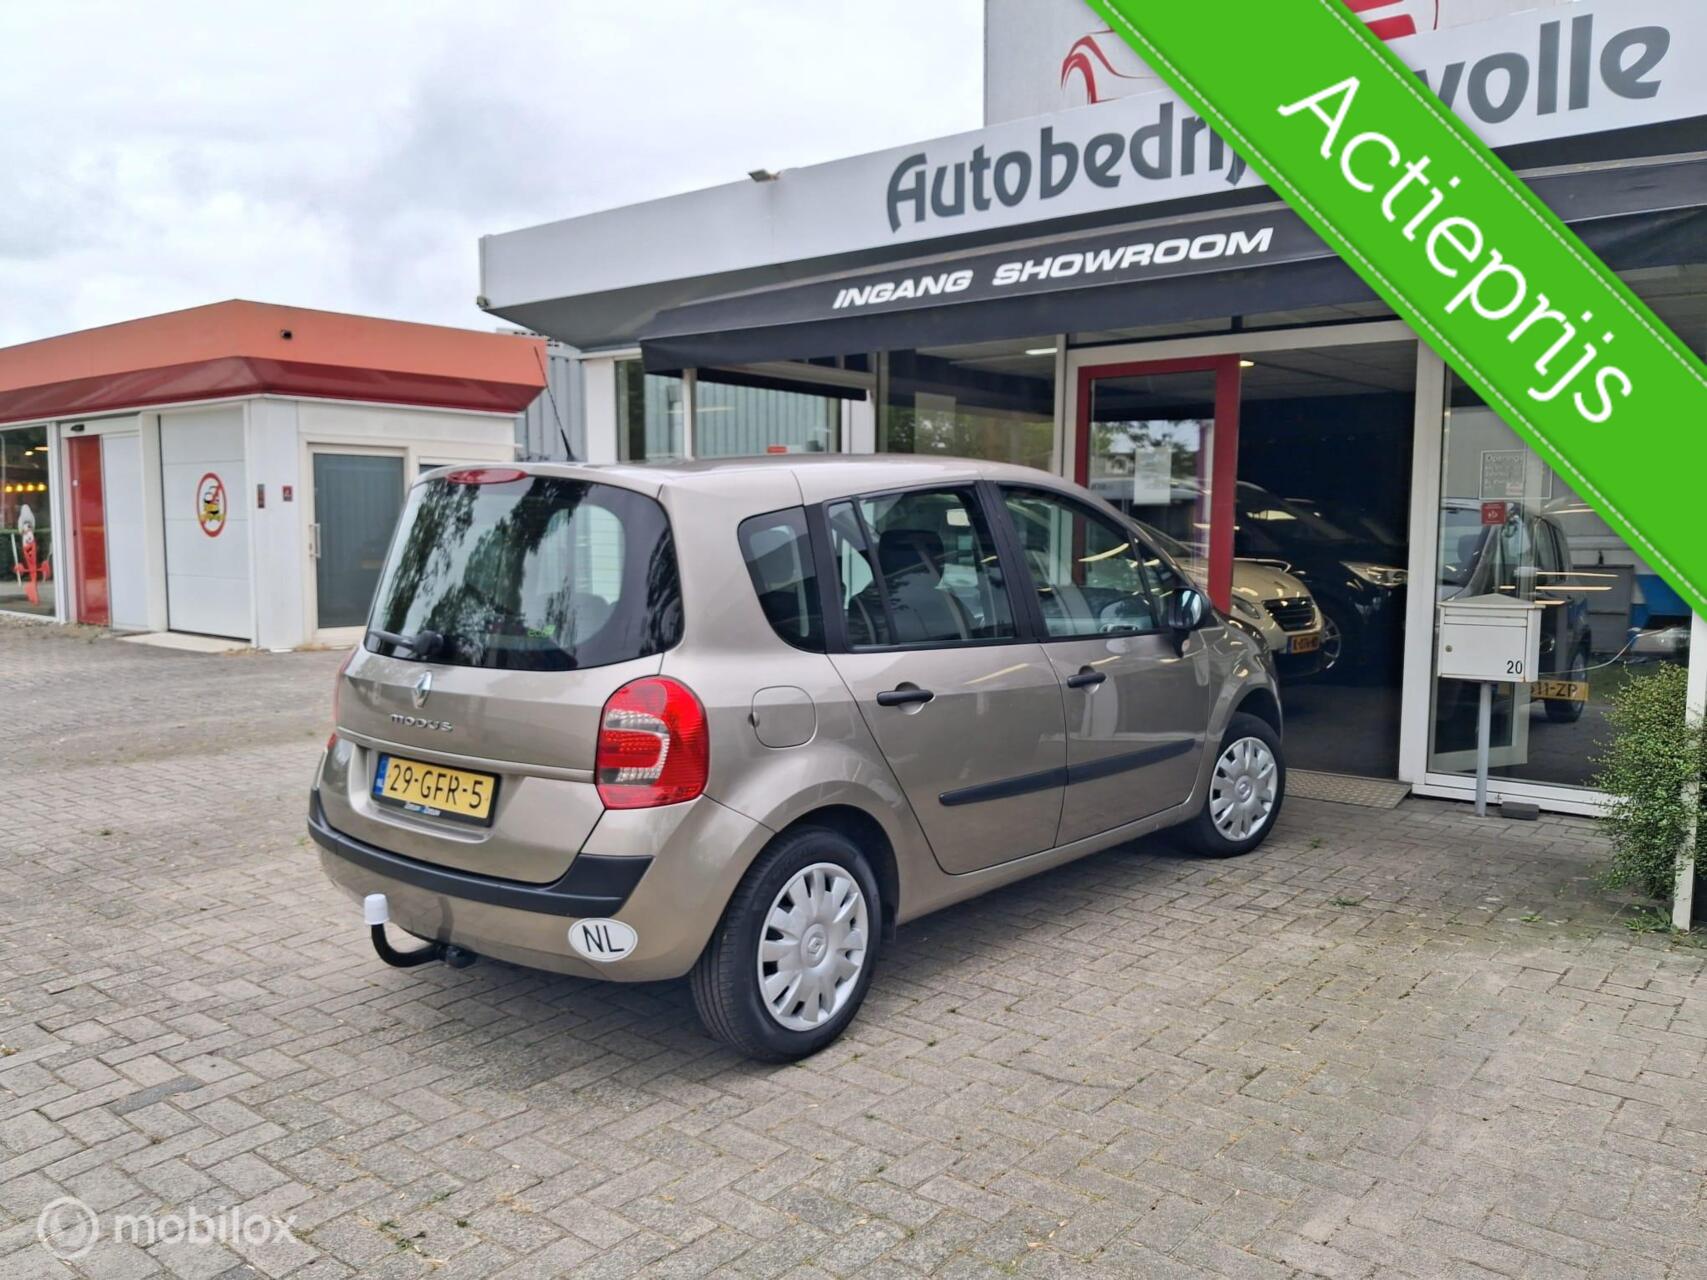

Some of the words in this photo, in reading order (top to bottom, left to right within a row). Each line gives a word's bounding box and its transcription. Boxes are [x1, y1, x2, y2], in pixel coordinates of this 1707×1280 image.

[832, 270, 974, 310] INGANG
[993, 227, 1274, 288] SHOWROOM
[1506, 660, 1523, 674] 20
[389, 764, 484, 809] 29-GFR-5
[582, 924, 625, 953] NL
